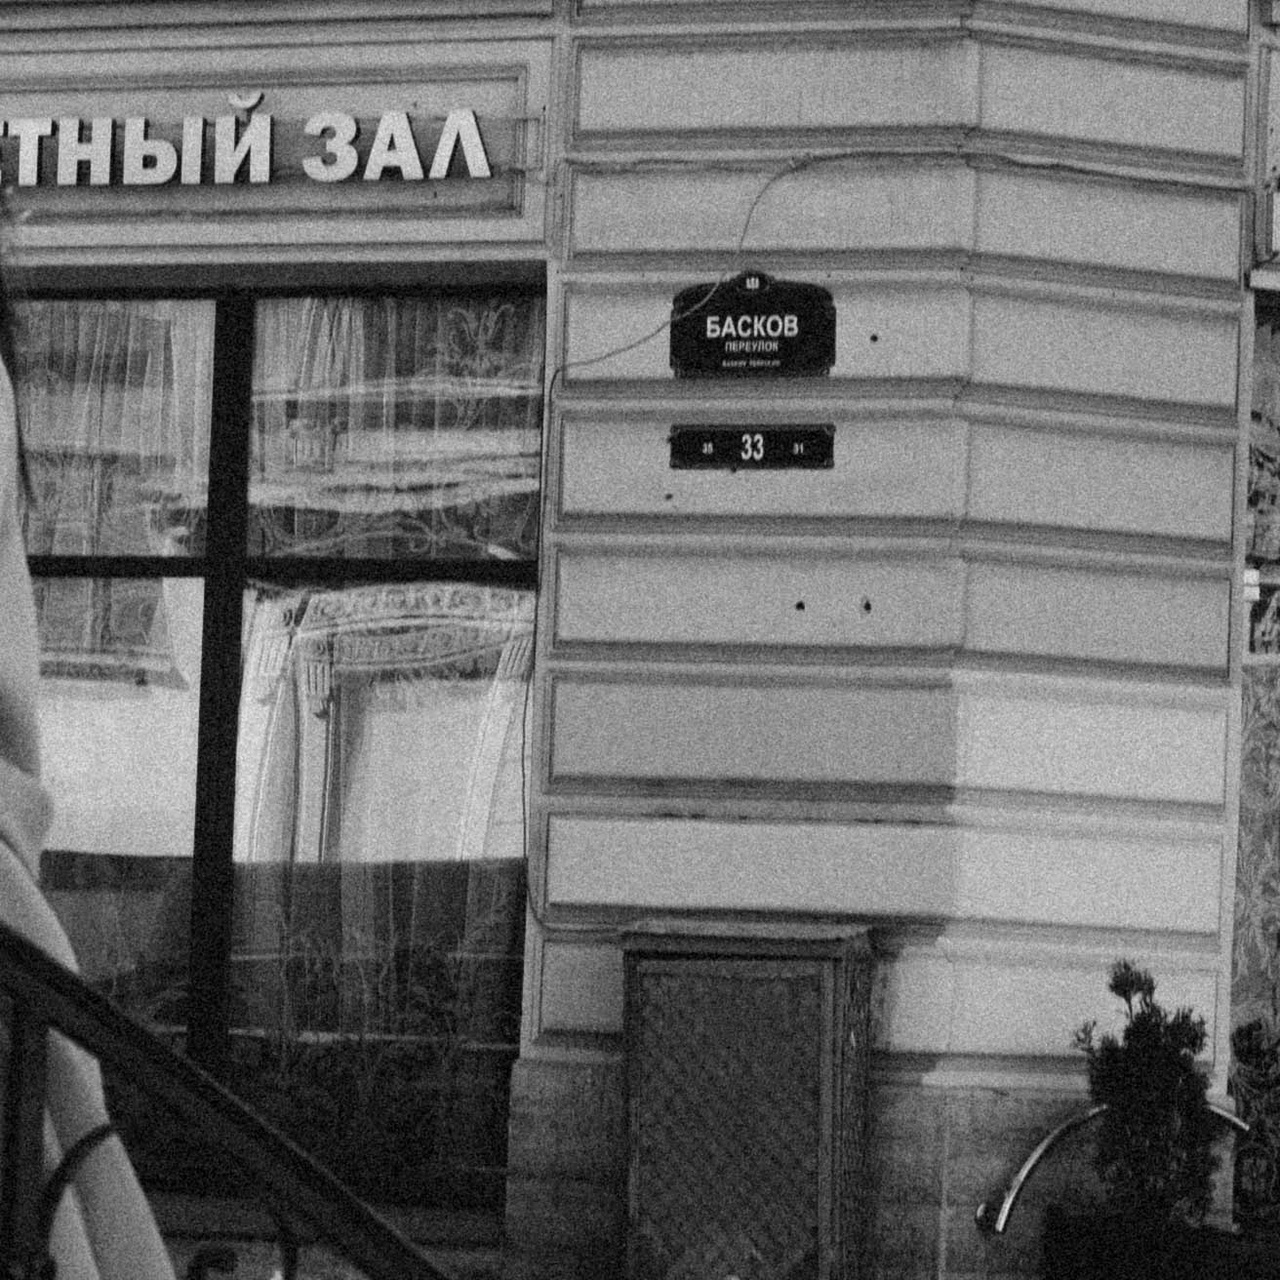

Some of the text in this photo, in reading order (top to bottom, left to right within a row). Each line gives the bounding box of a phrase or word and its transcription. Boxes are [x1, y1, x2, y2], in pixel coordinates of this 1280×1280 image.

[301, 108, 492, 183] ЗАЛ
[706, 315, 799, 338] БАСКОВ
[724, 340, 779, 353] ПЕРЕУЛОК
[740, 433, 765, 461] 33
